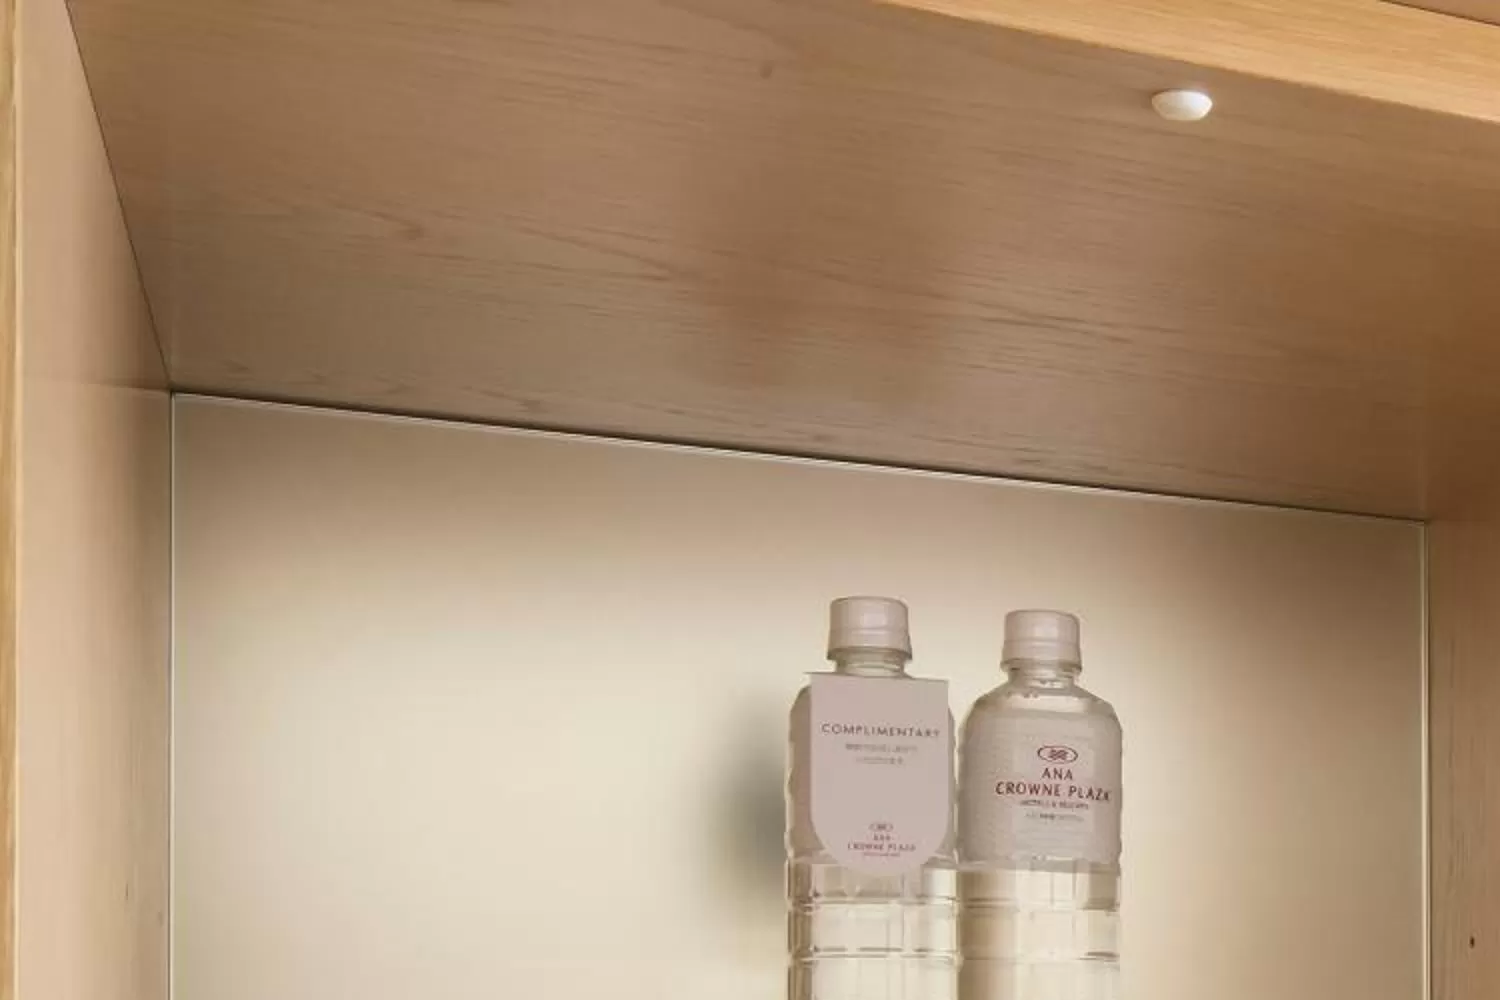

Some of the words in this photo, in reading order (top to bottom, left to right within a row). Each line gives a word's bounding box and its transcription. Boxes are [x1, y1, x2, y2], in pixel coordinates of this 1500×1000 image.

[821, 722, 941, 738] COMPLIMENTARY
[1041, 767, 1073, 781] ANA
[995, 781, 1061, 797] CROWNE
[1067, 785, 1111, 802] PLAZA
